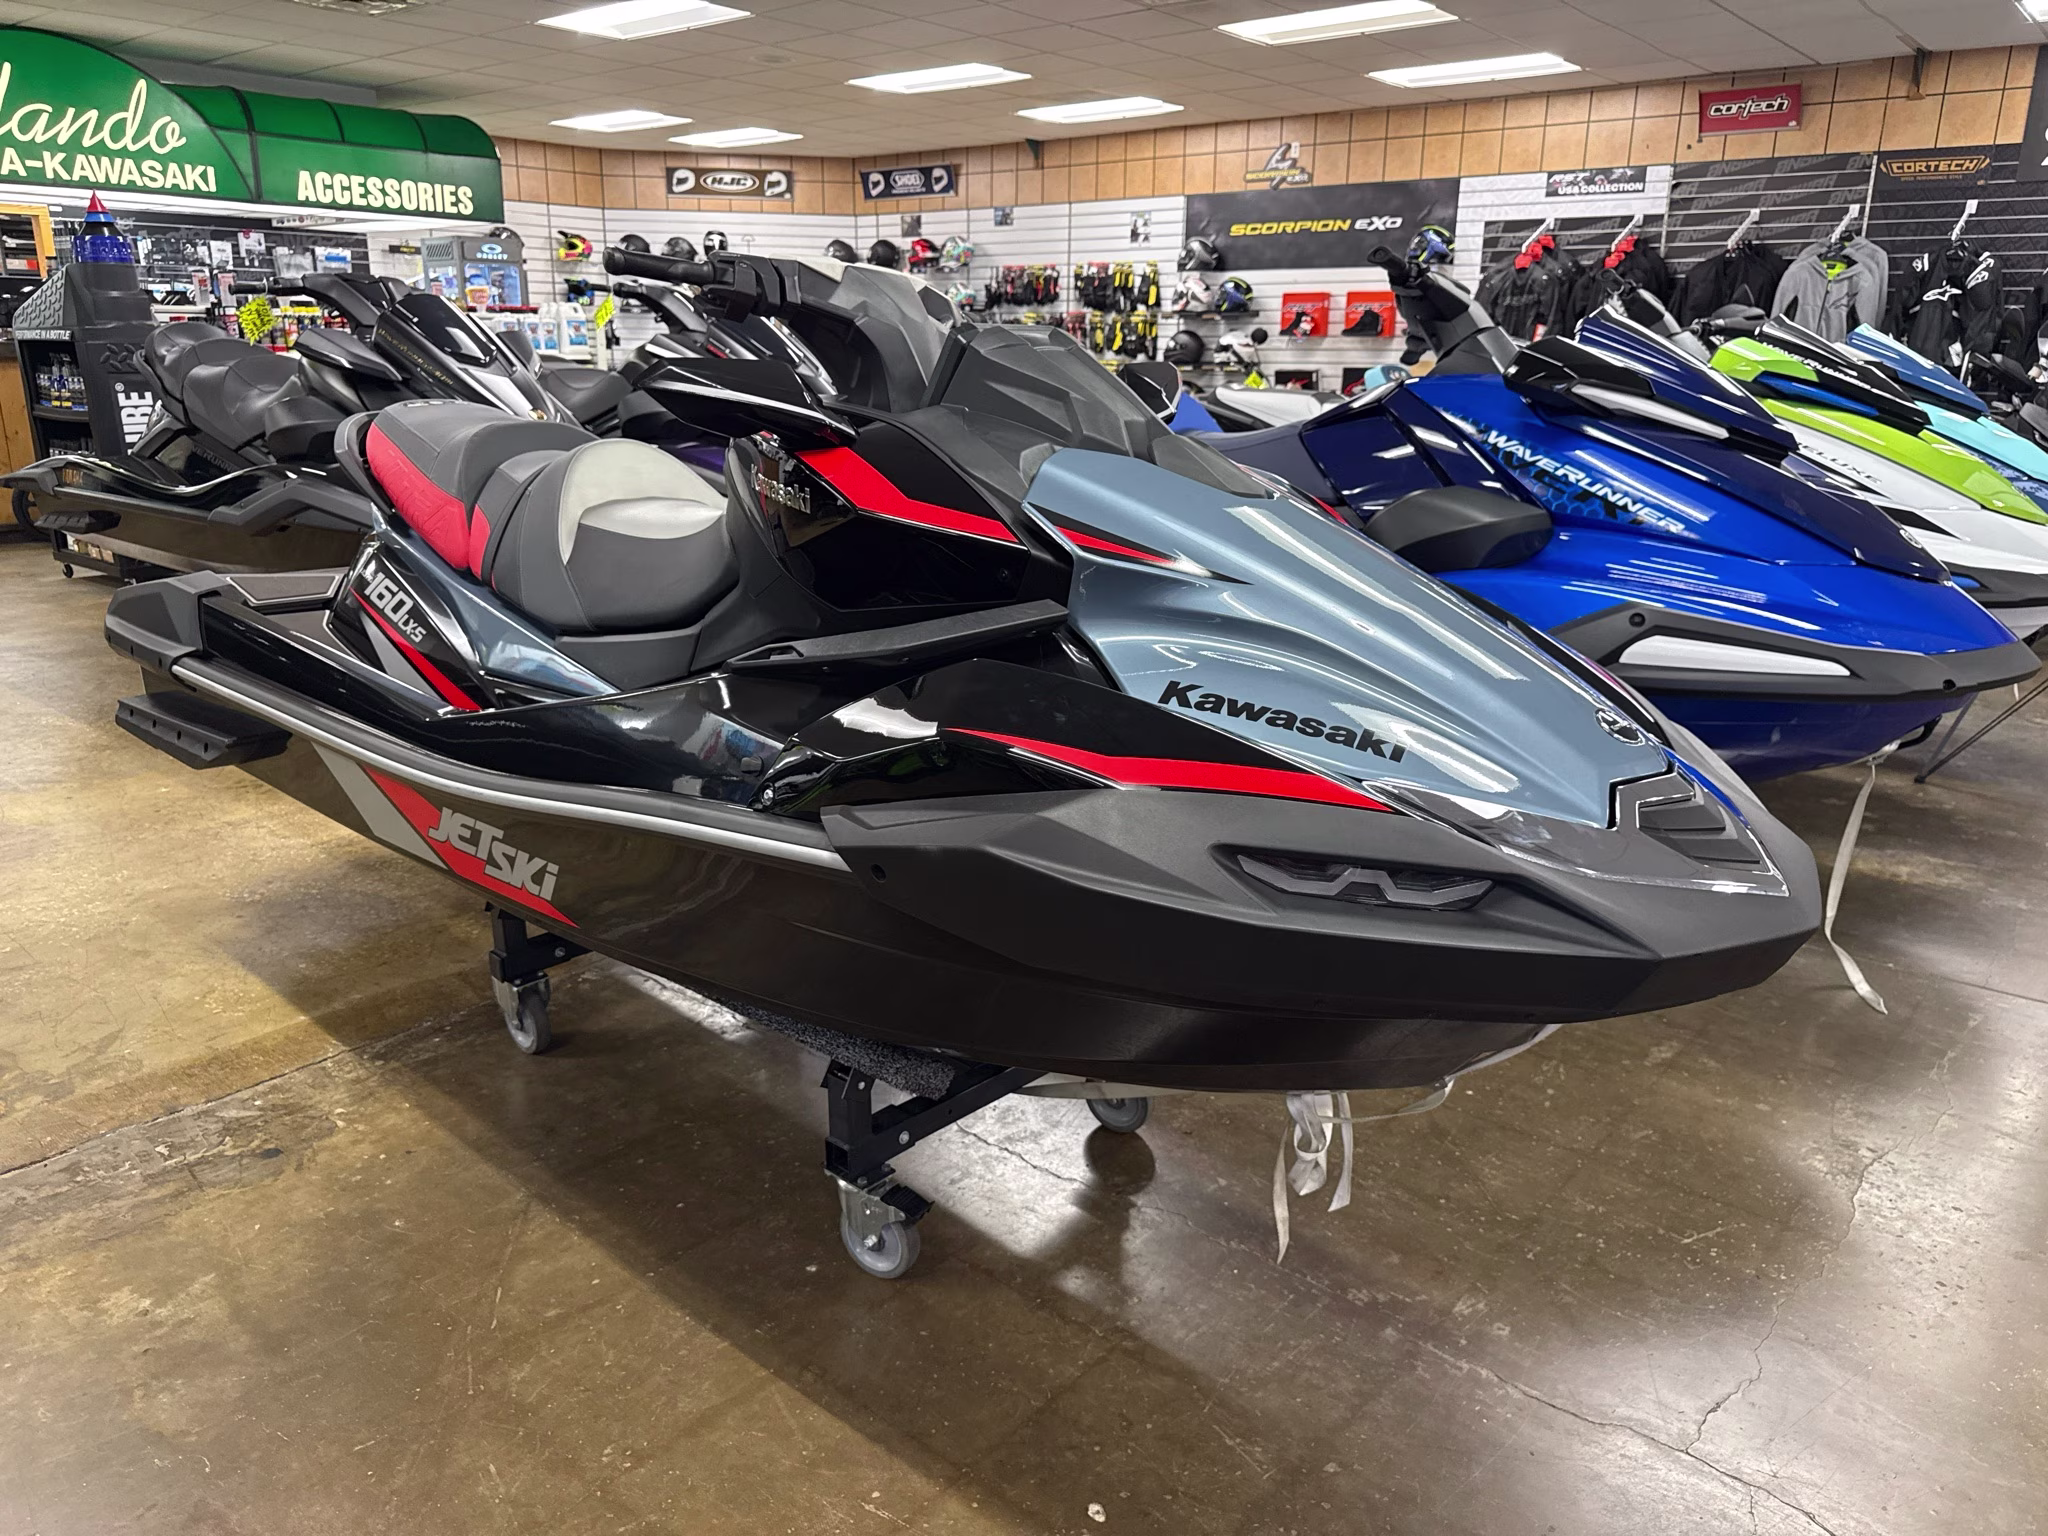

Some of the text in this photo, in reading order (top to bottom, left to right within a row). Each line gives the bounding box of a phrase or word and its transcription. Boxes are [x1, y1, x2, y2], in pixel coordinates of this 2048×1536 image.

[1709, 94, 1789, 119] cortech
[1, 147, 217, 192] A-KAWASAKI
[710, 176, 749, 187] HJC
[1891, 159, 1978, 173] CORTECH
[297, 170, 474, 216] ACCESSORIES
[1557, 182, 1644, 195] USA COLLECTION
[1229, 218, 1353, 237] SCORPION
[51, 330, 71, 340] BOTTLE
[1797, 442, 1883, 485] ELUXE
[751, 463, 811, 514] Kawasaki
[1487, 430, 1687, 534] WAVERUNNER
[1158, 680, 1408, 763] Kawasaki
